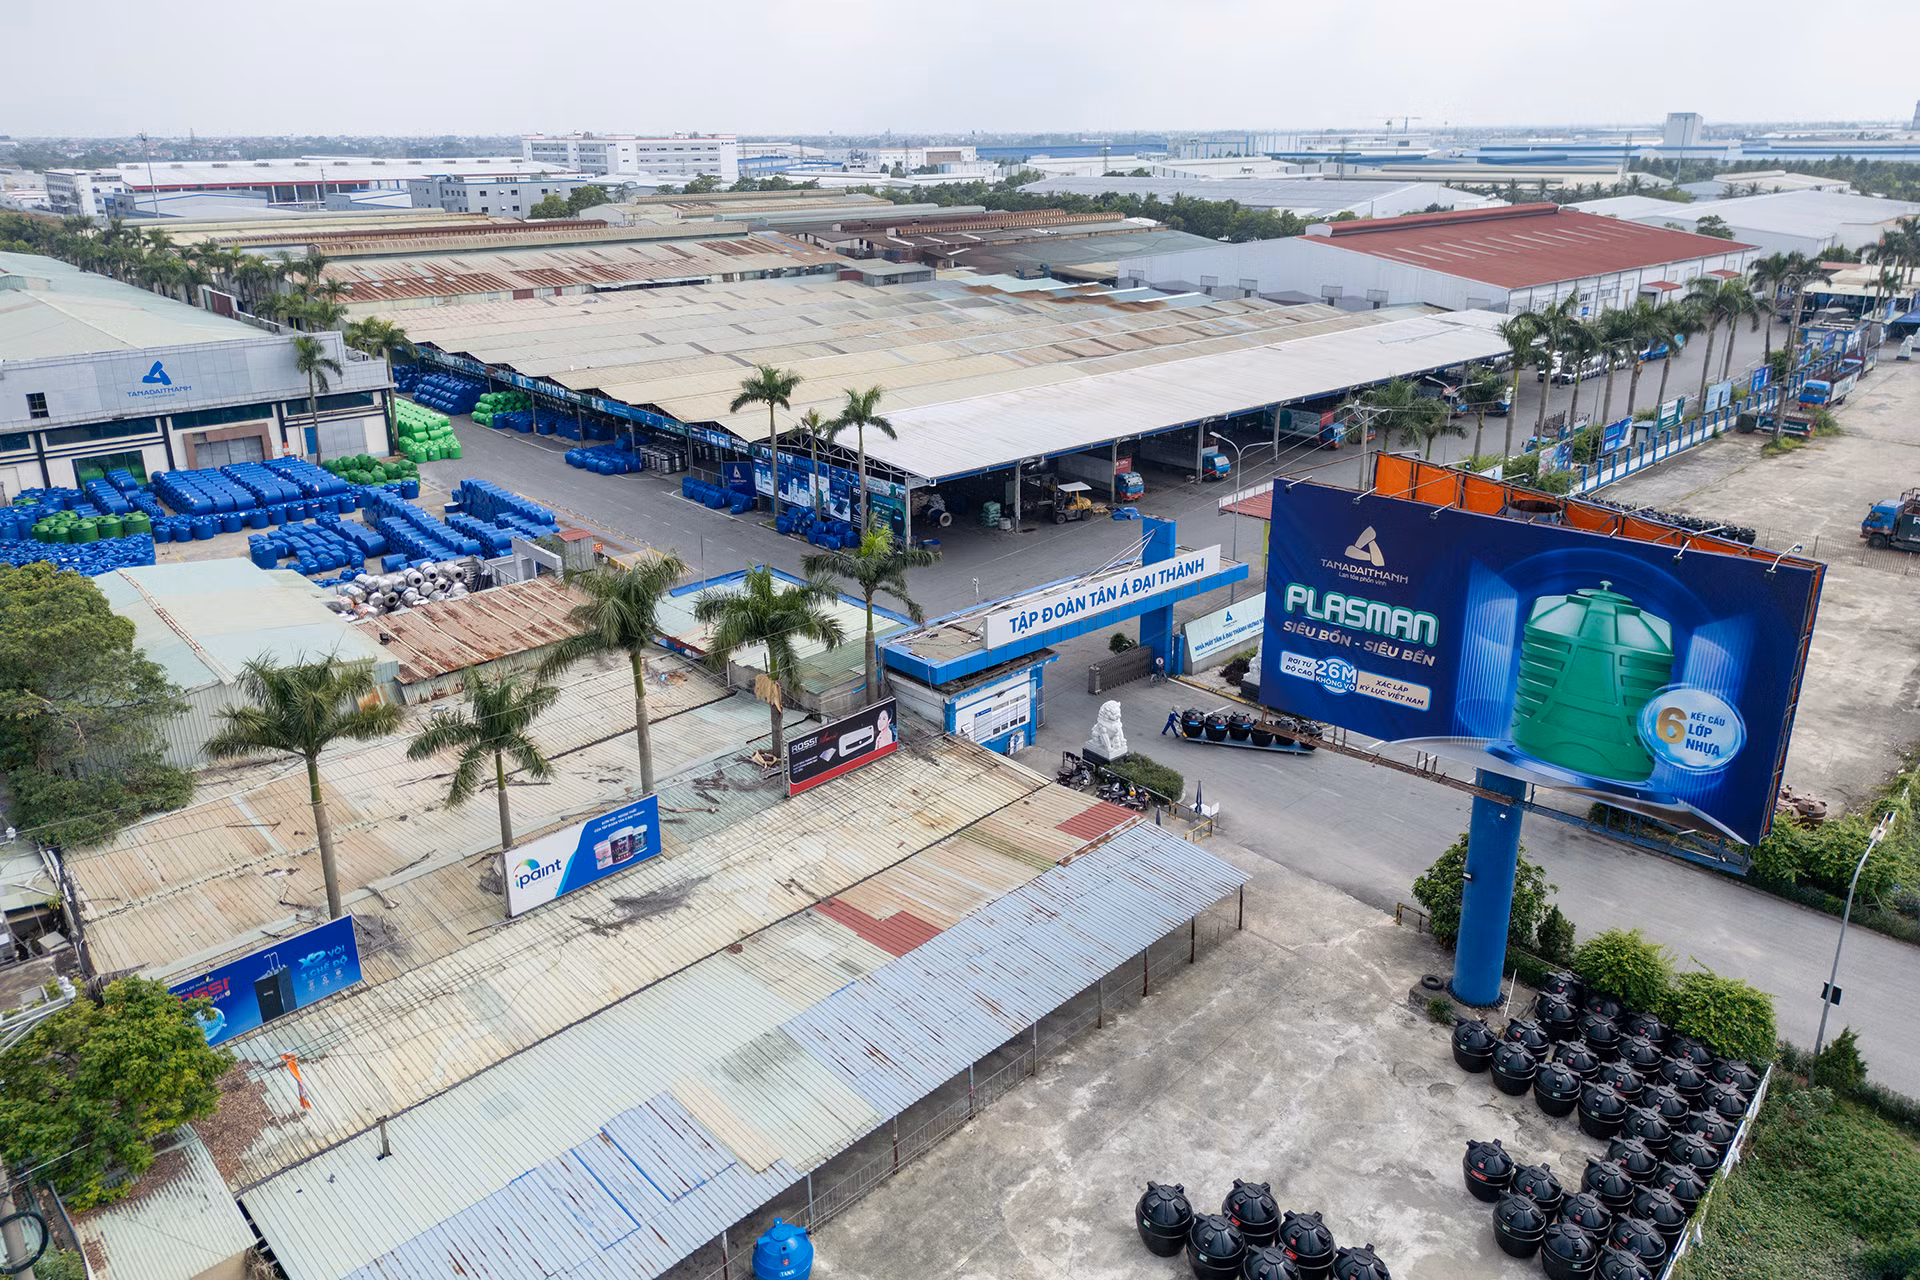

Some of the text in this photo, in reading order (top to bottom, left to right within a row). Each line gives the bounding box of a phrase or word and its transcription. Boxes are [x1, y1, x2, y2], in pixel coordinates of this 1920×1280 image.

[127, 386, 192, 397] TANADAITHANH
[1321, 559, 1408, 584] TANADAITHANH
[1009, 558, 1204, 634] TẬP ĐOÀN TÂN Á ĐẠI THÀNH
[1285, 583, 1438, 646] PLASMAN
[1283, 621, 1316, 637] SIÊU
[1319, 630, 1351, 647] BỒN
[1364, 641, 1399, 657] SIÊU
[1402, 650, 1435, 666] BỀN
[1286, 664, 1312, 676] ĐỘ CAO
[1288, 657, 1300, 665] RƠI
[1316, 660, 1357, 684] 26M
[1316, 676, 1342, 688] KHÔNG
[1376, 680, 1391, 689] XÁC
[1388, 691, 1404, 700] VIỆT
[1406, 697, 1424, 706] NAM
[1656, 707, 1687, 744] 6
[1691, 712, 1725, 726] KẾT CẤU
[1688, 723, 1712, 738] LỚP
[792, 736, 818, 753] ROSSI
[1685, 738, 1720, 756] NHỰA
[514, 859, 562, 890] ipaint
[298, 945, 345, 970] X2 VÒI
[310, 961, 330, 976] CHẾ
[333, 955, 348, 967] ĐỘ
